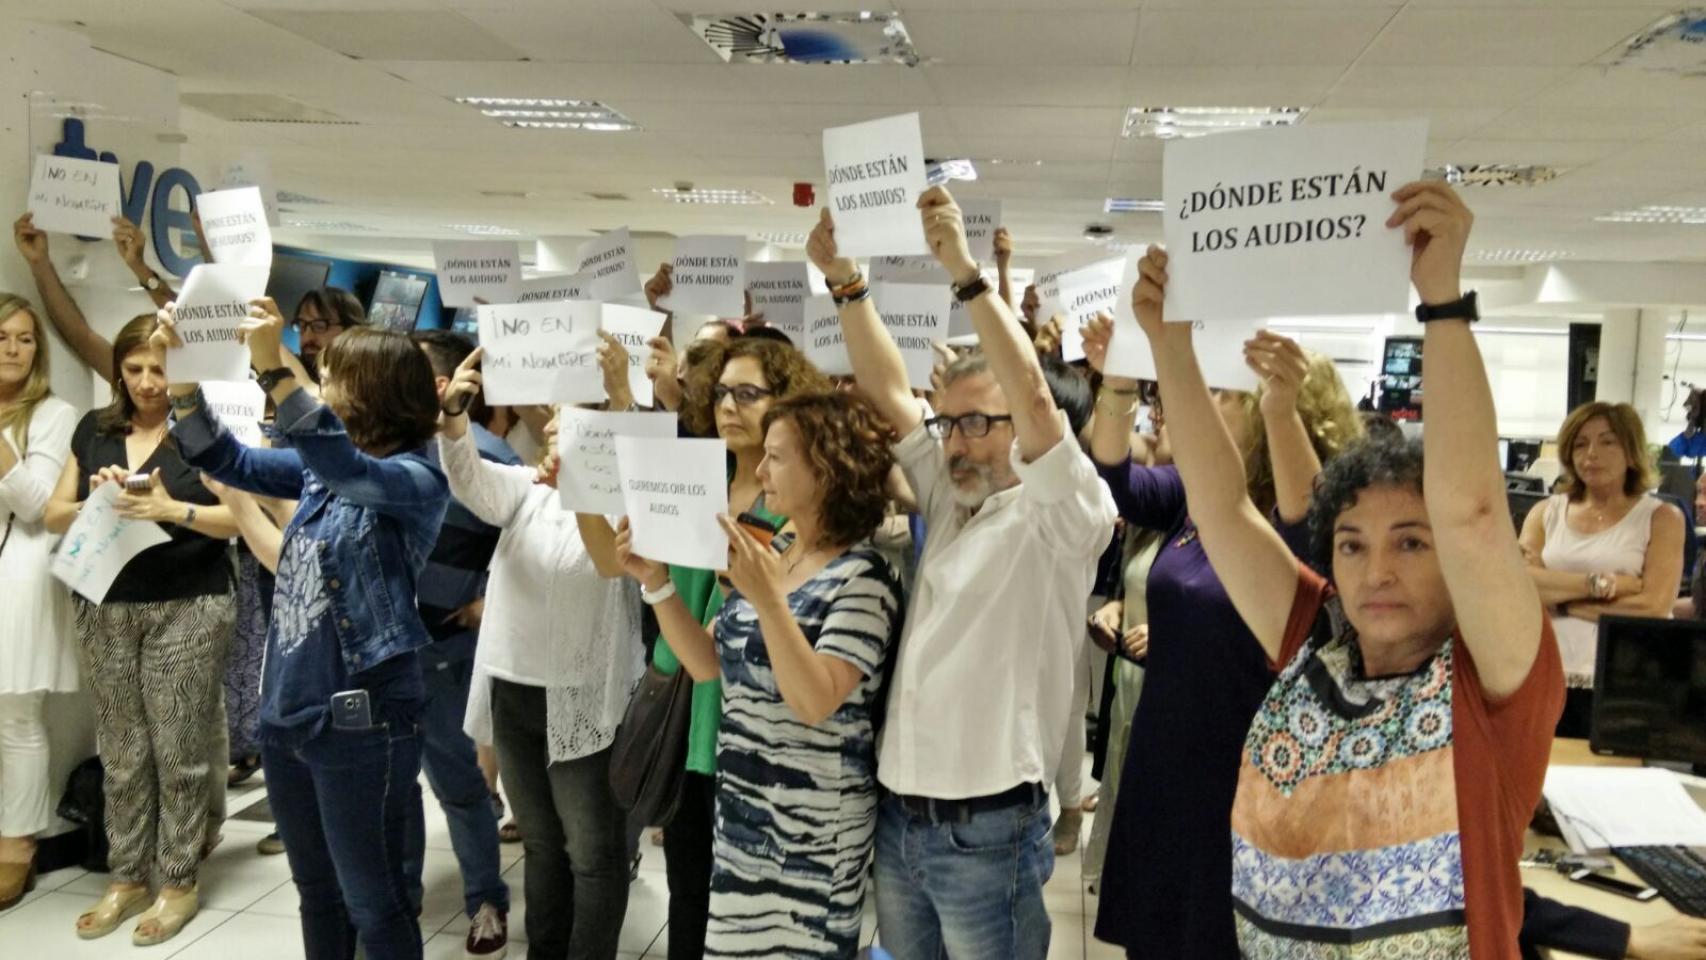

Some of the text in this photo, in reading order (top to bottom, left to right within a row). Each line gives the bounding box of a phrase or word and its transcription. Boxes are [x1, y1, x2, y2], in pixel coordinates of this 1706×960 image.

[866, 154, 908, 179] ESTÁN
[836, 187, 907, 212] LOS AUDIOS?
[1179, 165, 1388, 220] ¿DÓNDE ESTÁN
[1191, 213, 1367, 253] LOS AUDIOS?
[710, 252, 738, 268] ESTÁN
[449, 275, 467, 284] LOS
[676, 273, 735, 287] LOS AUDIOS?
[214, 300, 247, 319] ESTÁN
[541, 314, 573, 334] EN
[810, 315, 839, 333] ¿DÓND
[906, 311, 938, 328] ESTÁN
[184, 330, 205, 344] LOS
[814, 334, 832, 349] LOS
[687, 483, 707, 497] LOS
[649, 503, 680, 516] AUDIOS
